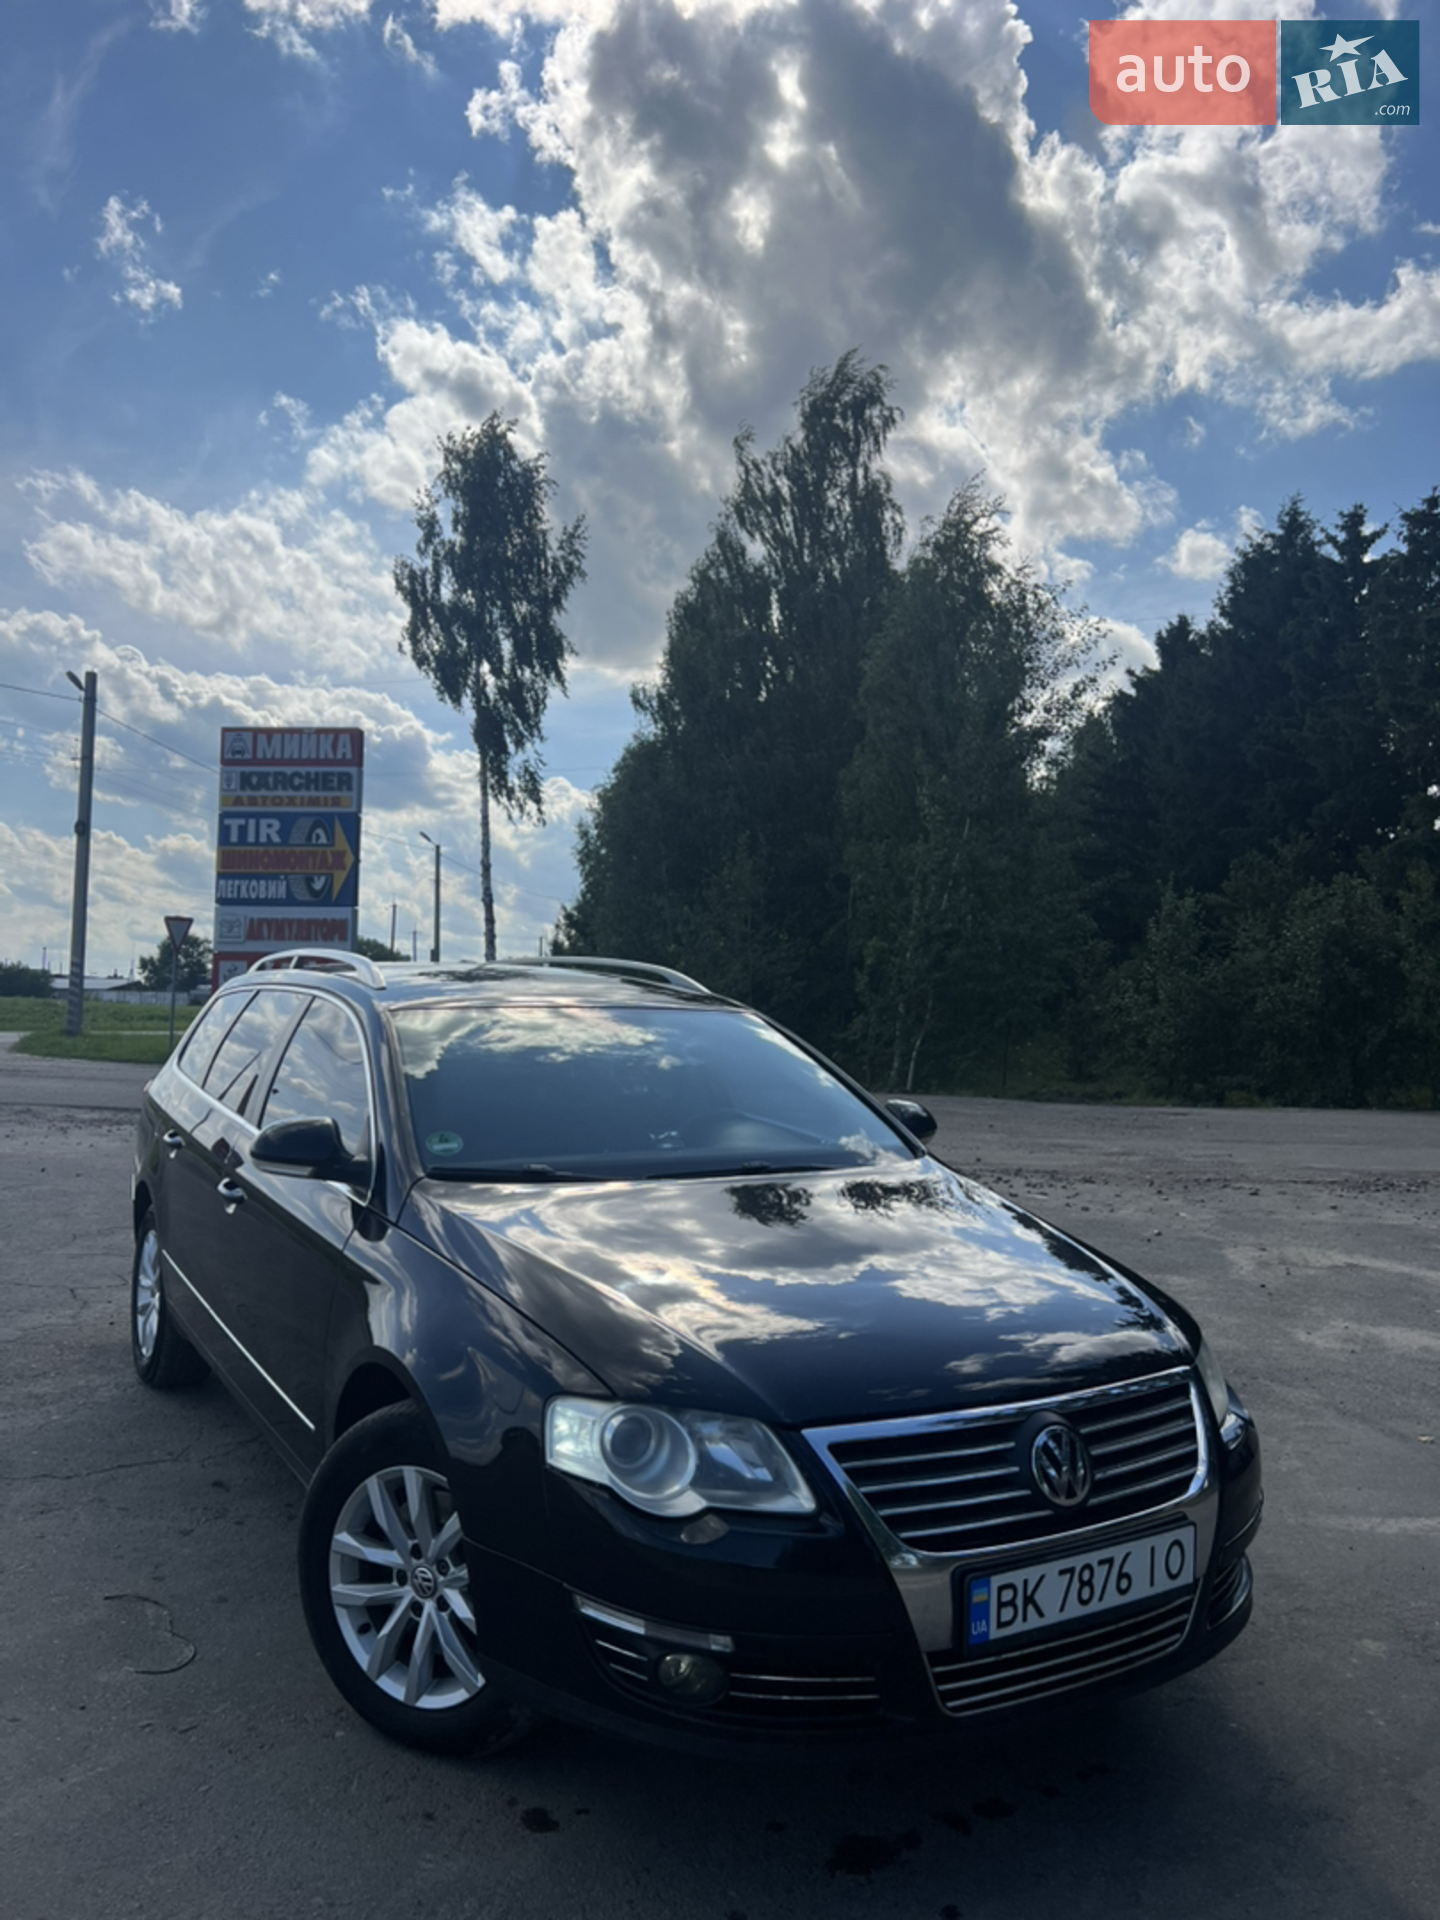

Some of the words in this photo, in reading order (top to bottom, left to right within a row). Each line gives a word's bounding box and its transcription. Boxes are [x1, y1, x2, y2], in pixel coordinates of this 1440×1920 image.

[256, 729, 353, 760] МИЙКА
[223, 817, 282, 844] TIR
[220, 849, 348, 871] ШИНОМОНТАЖ
[216, 875, 287, 899] ЛЕГКОВИЙ
[996, 1573, 1046, 1630] BK
[1057, 1551, 1133, 1613] 7876
[1149, 1539, 1186, 1588] IO
[971, 1619, 989, 1636] UA
